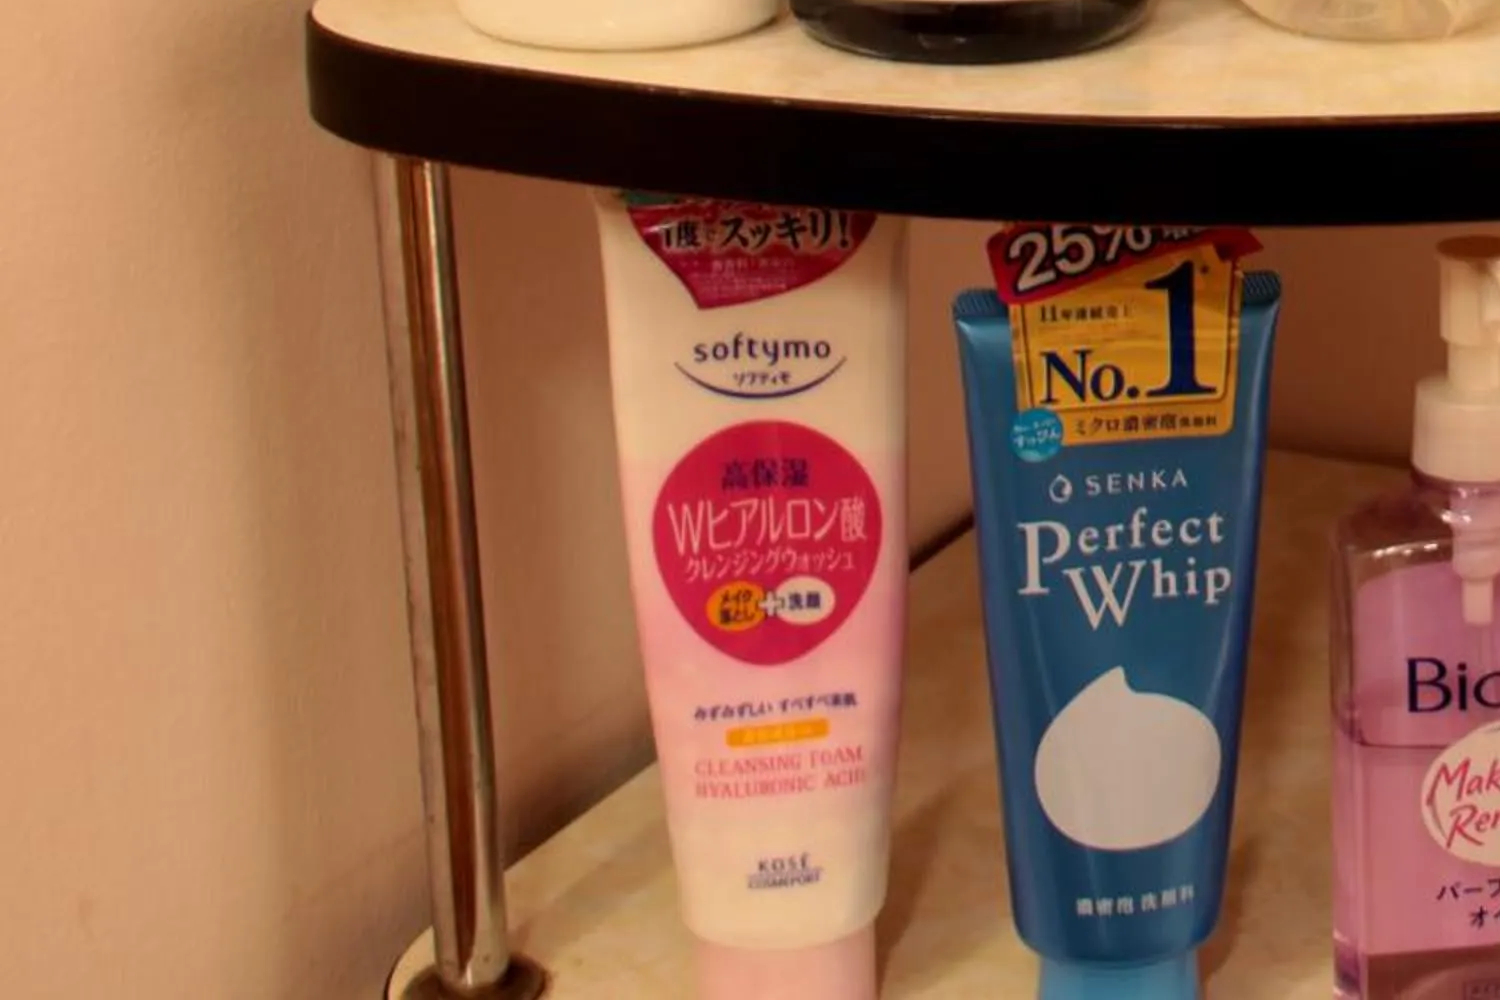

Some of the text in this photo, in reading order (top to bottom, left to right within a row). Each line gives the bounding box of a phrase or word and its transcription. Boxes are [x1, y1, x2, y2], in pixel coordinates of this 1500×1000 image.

[1008, 225, 1152, 292] 25%
[693, 331, 832, 366] softymo
[733, 371, 792, 388] ソフティモ
[722, 457, 810, 491] 高保湿
[1085, 467, 1190, 496] SENKA
[667, 493, 868, 557] Wヒアルロン酸
[686, 545, 856, 583] クレンジングウォッシュ
[1016, 506, 1224, 595] Perfect
[1062, 556, 1233, 632] Whip
[695, 745, 864, 777] CLEANSING FOAM
[695, 766, 869, 800] HYALURONIC ACID
